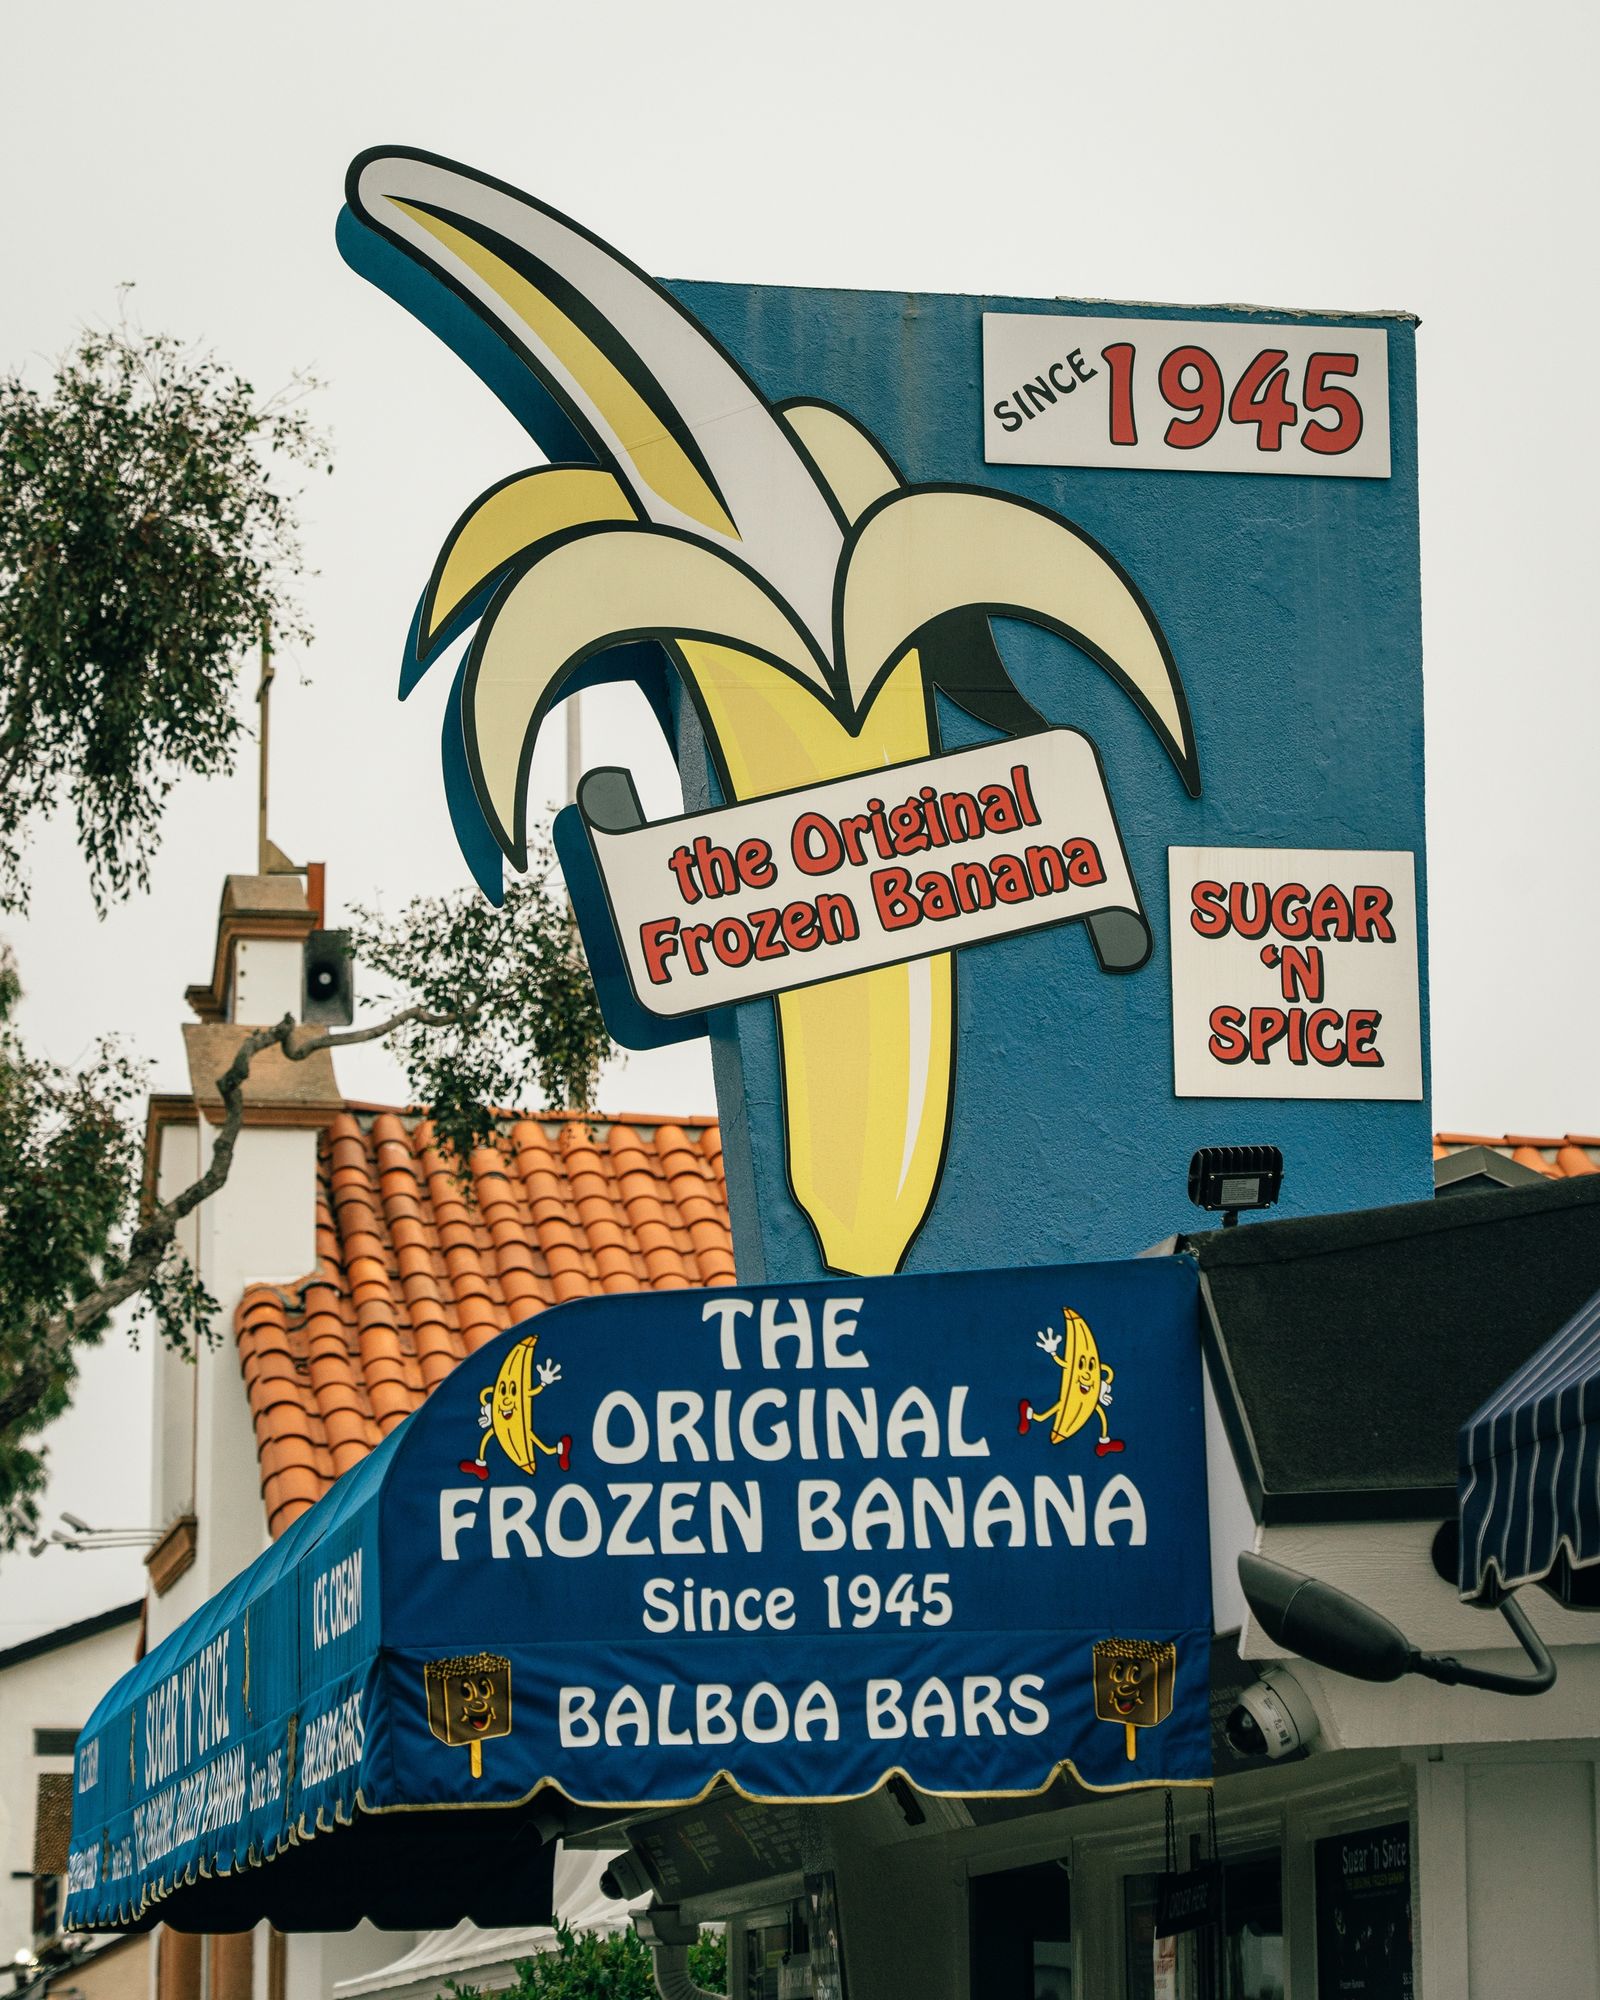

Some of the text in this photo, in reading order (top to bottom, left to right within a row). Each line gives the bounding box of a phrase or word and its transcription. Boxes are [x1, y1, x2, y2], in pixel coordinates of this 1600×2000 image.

[993, 342, 1364, 455] SINCE 1945
[668, 763, 1042, 904] the Original
[639, 837, 1107, 985] Frozen Banana
[1190, 880, 1397, 943] SUGAR
[1208, 1005, 1385, 1067] SPICE
[701, 1297, 870, 1370] THE
[592, 1385, 990, 1465] ORIGINAL
[439, 1473, 1148, 1561] FROZEN BANANA
[313, 1547, 364, 1652] ICE CREAM
[642, 1572, 954, 1634] Since 1945
[145, 1674, 179, 1791] SUGAR
[198, 1629, 230, 1757] SPICE
[558, 1674, 1050, 1748] BALBOA BARS
[1342, 1846, 1368, 1875] Sugar
[1382, 1837, 1407, 1871] Spice
